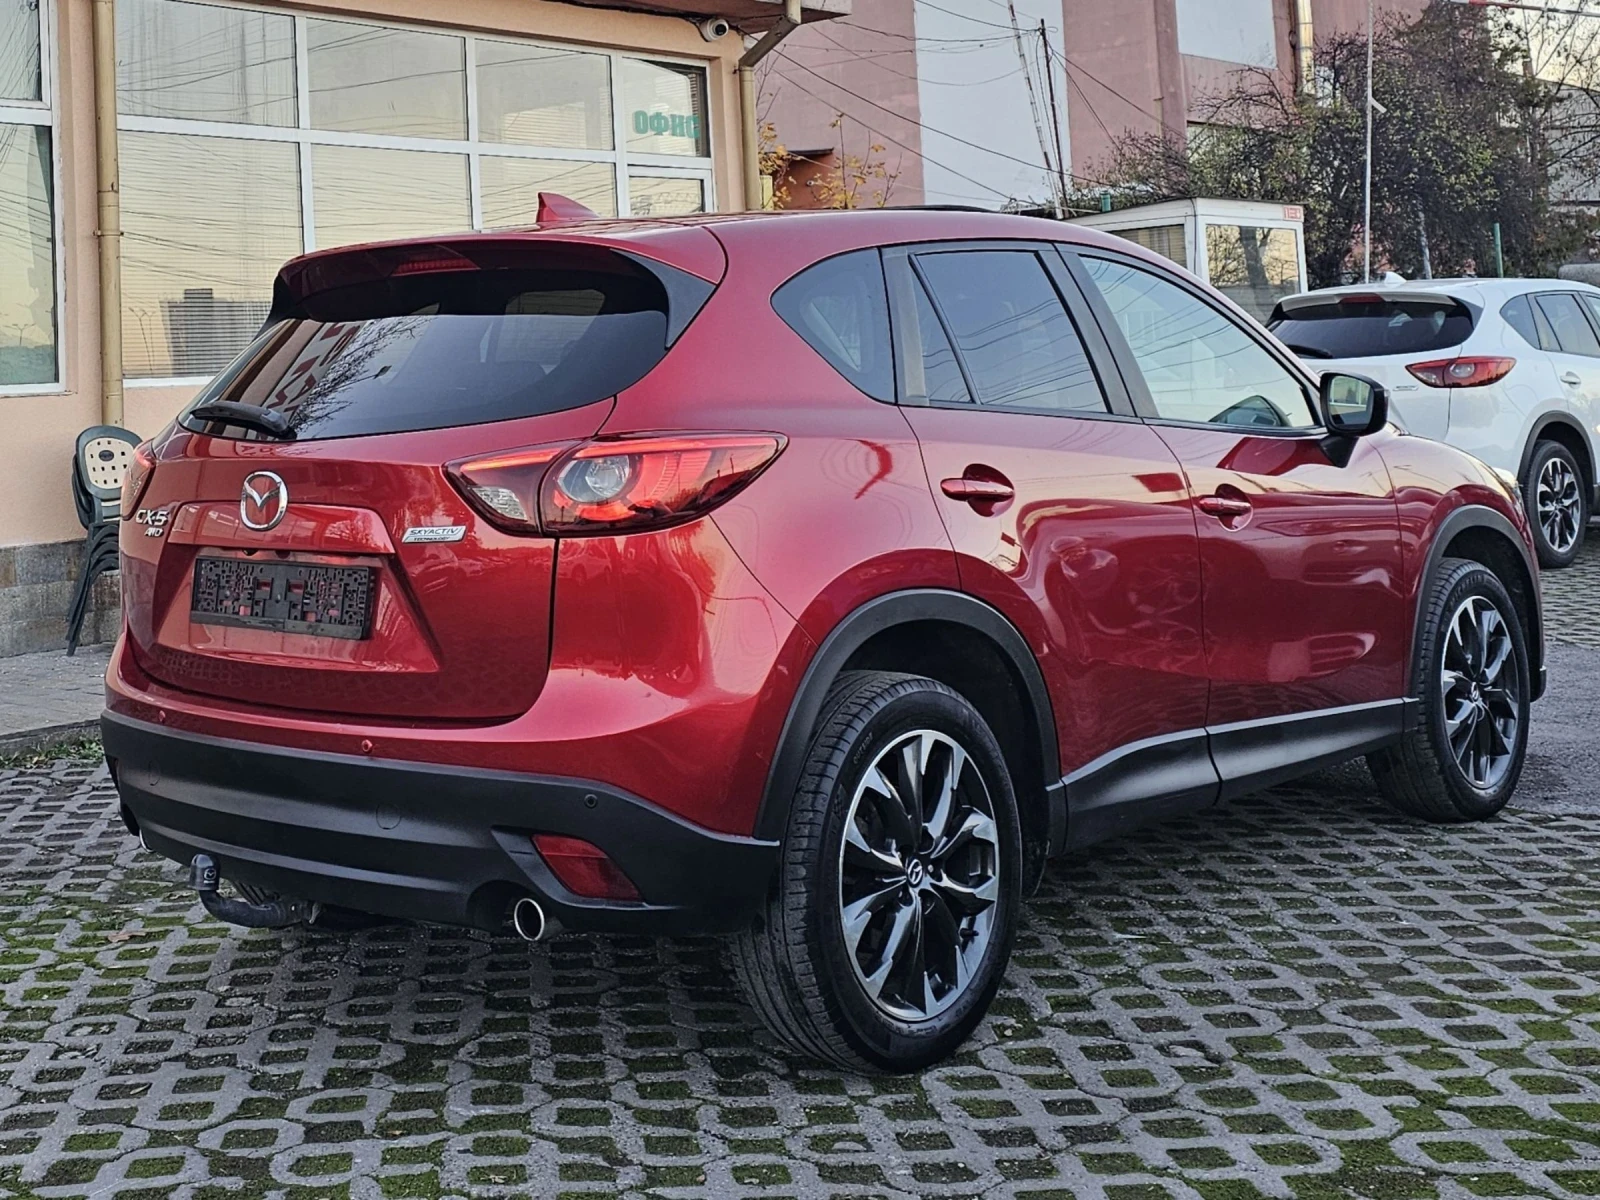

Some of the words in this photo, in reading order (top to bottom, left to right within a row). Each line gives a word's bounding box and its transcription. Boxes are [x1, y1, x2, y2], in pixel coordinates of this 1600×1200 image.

[632, 110, 701, 139] ОФИС
[144, 527, 164, 537] AWD
[410, 527, 459, 536] SKYACTIV
